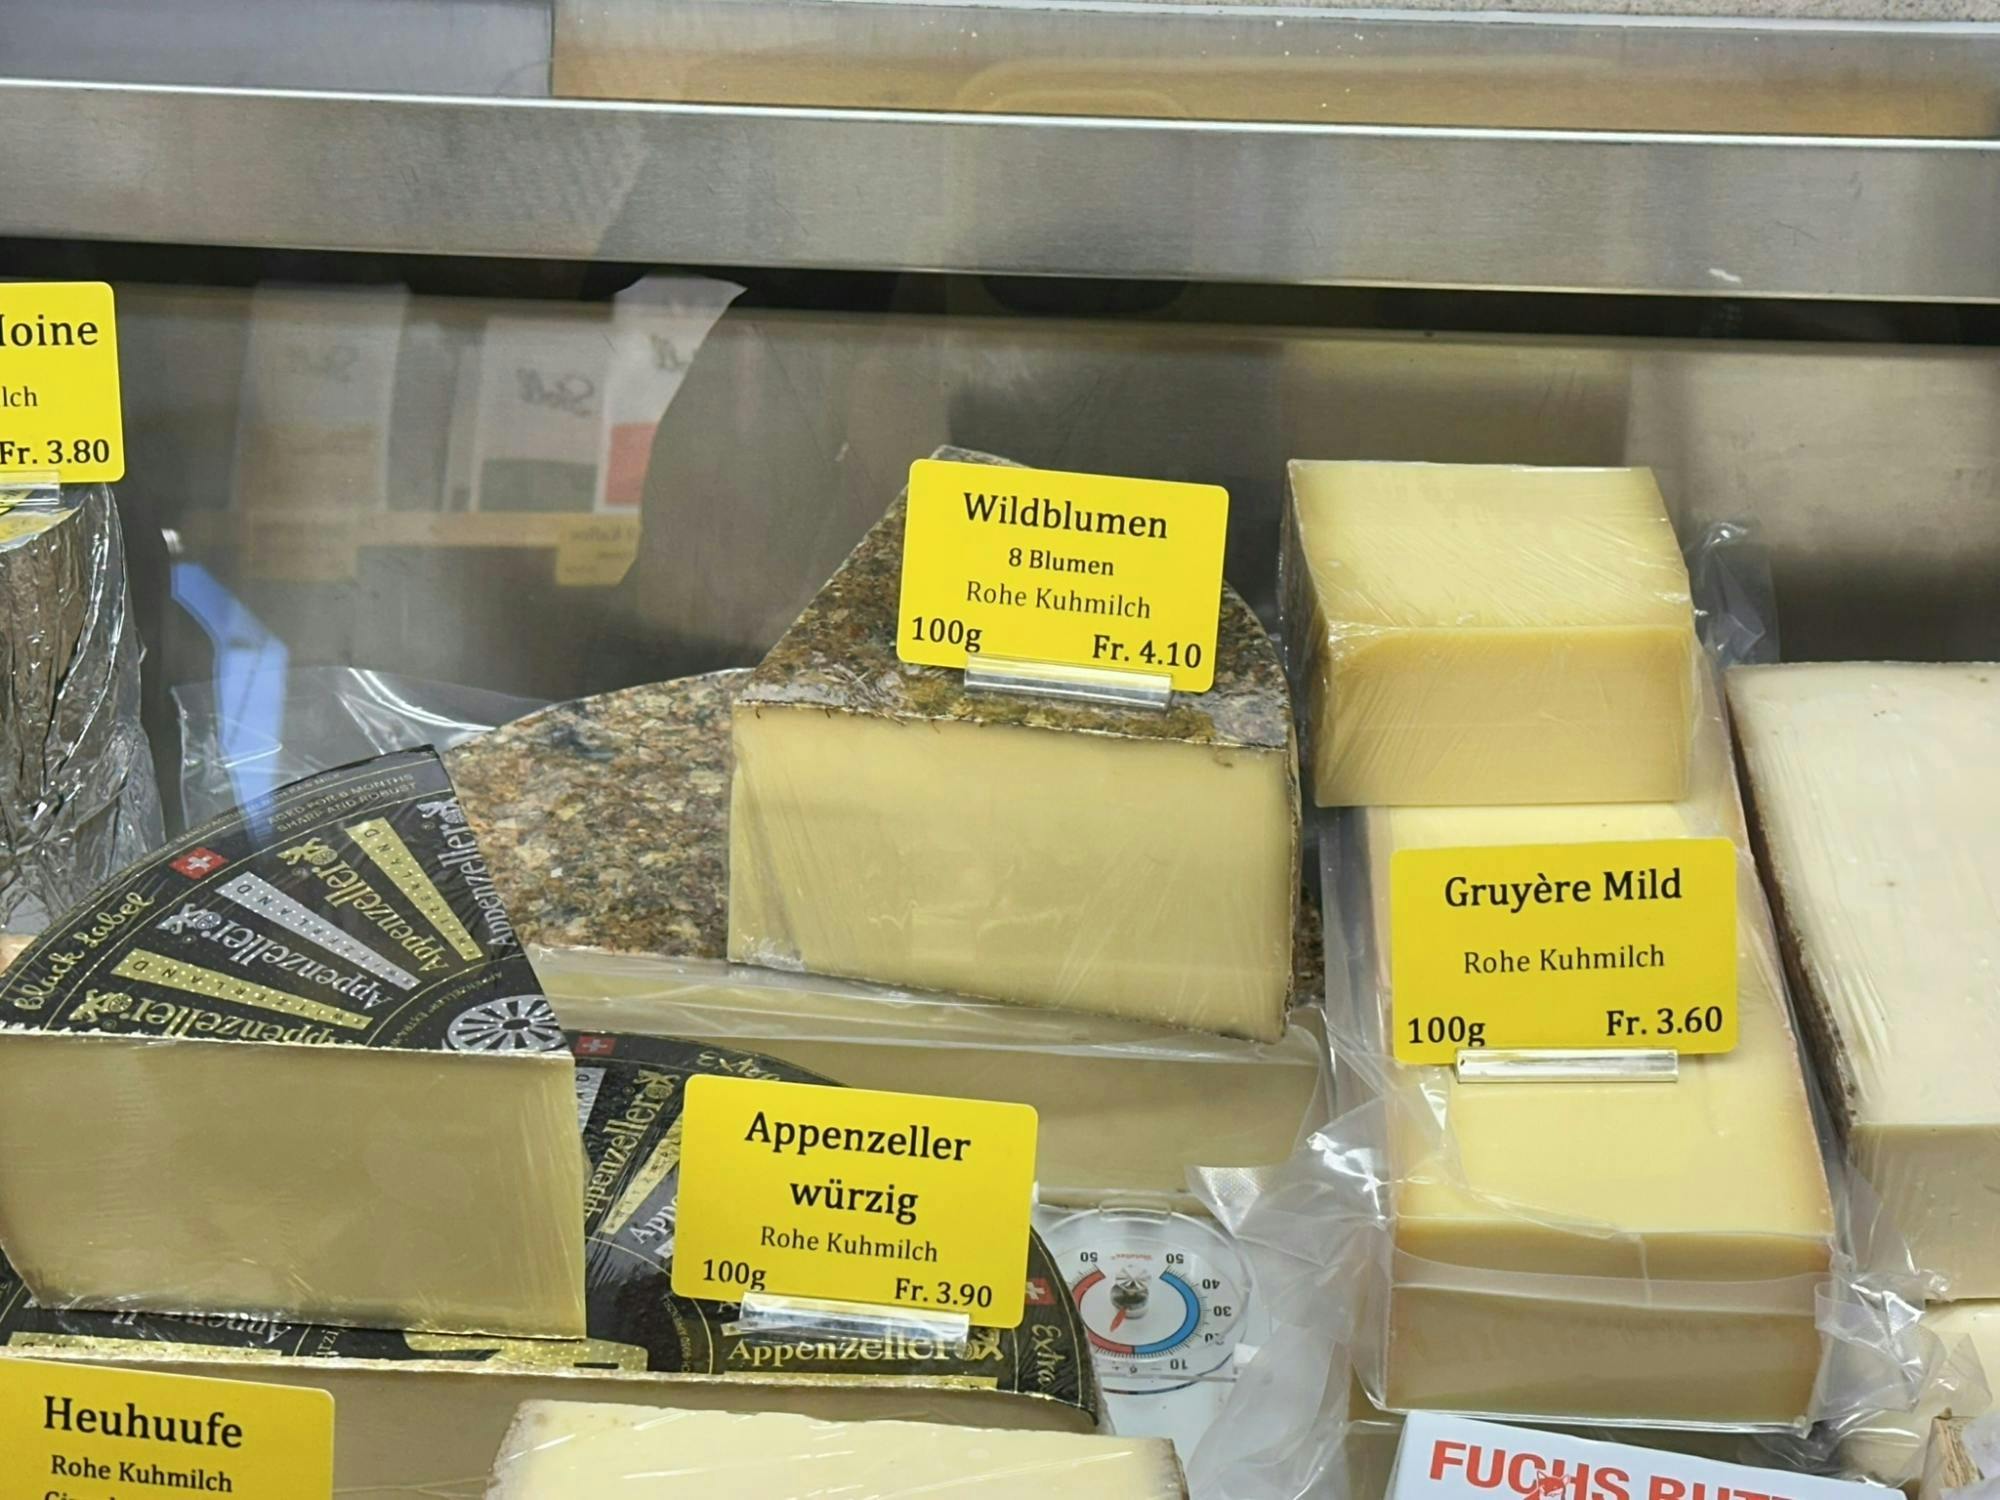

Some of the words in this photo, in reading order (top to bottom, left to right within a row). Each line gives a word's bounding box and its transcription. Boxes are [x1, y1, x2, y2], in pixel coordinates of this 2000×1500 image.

[0, 440, 37, 465] Fr.
[47, 438, 110, 465] 3.80
[963, 491, 1168, 539] Wildblumen
[1008, 547, 1022, 568] 8
[1029, 549, 1114, 576] Blumen
[966, 580, 1027, 607] Rohe
[1035, 587, 1151, 619] Kuhmilch
[911, 615, 983, 653] 100g
[1092, 634, 1129, 662] Fr.
[1139, 639, 1202, 669] 4.10
[1444, 872, 1591, 914] Gruyère
[1603, 867, 1682, 901] Mild
[312, 860, 449, 972] Appenzeller
[14, 949, 85, 1011] Black
[73, 891, 155, 948] Label
[201, 918, 393, 1010] Appenzeller
[1463, 950, 1531, 974] Rohe
[1540, 944, 1665, 971] Kuhmilch
[119, 997, 340, 1045] ppenzeller
[1407, 1015, 1486, 1047] 100g
[1606, 1009, 1647, 1036] Fr.
[1656, 1005, 1723, 1034] 3.60
[584, 1094, 664, 1217] ppenzeller
[744, 1111, 971, 1162] Appenzeller
[790, 1178, 919, 1226] würzig
[760, 1225, 819, 1250] Rohe
[826, 1232, 938, 1262] Kuhmilch
[1080, 1251, 1098, 1262] 50
[1165, 1253, 1184, 1264] 50
[702, 1258, 766, 1292] 100g
[894, 1277, 929, 1303] Fr.
[935, 1281, 992, 1308] 3.90
[1202, 1279, 1220, 1289] 40
[1213, 1305, 1231, 1316] 30
[1031, 1323, 1066, 1387] Extra
[1169, 1358, 1188, 1370] 10
[44, 1395, 243, 1448] Heuhuufe
[51, 1454, 111, 1479] Rohe
[119, 1461, 233, 1493] Kuhmilch
[1429, 1439, 1631, 1500] FUCHS
